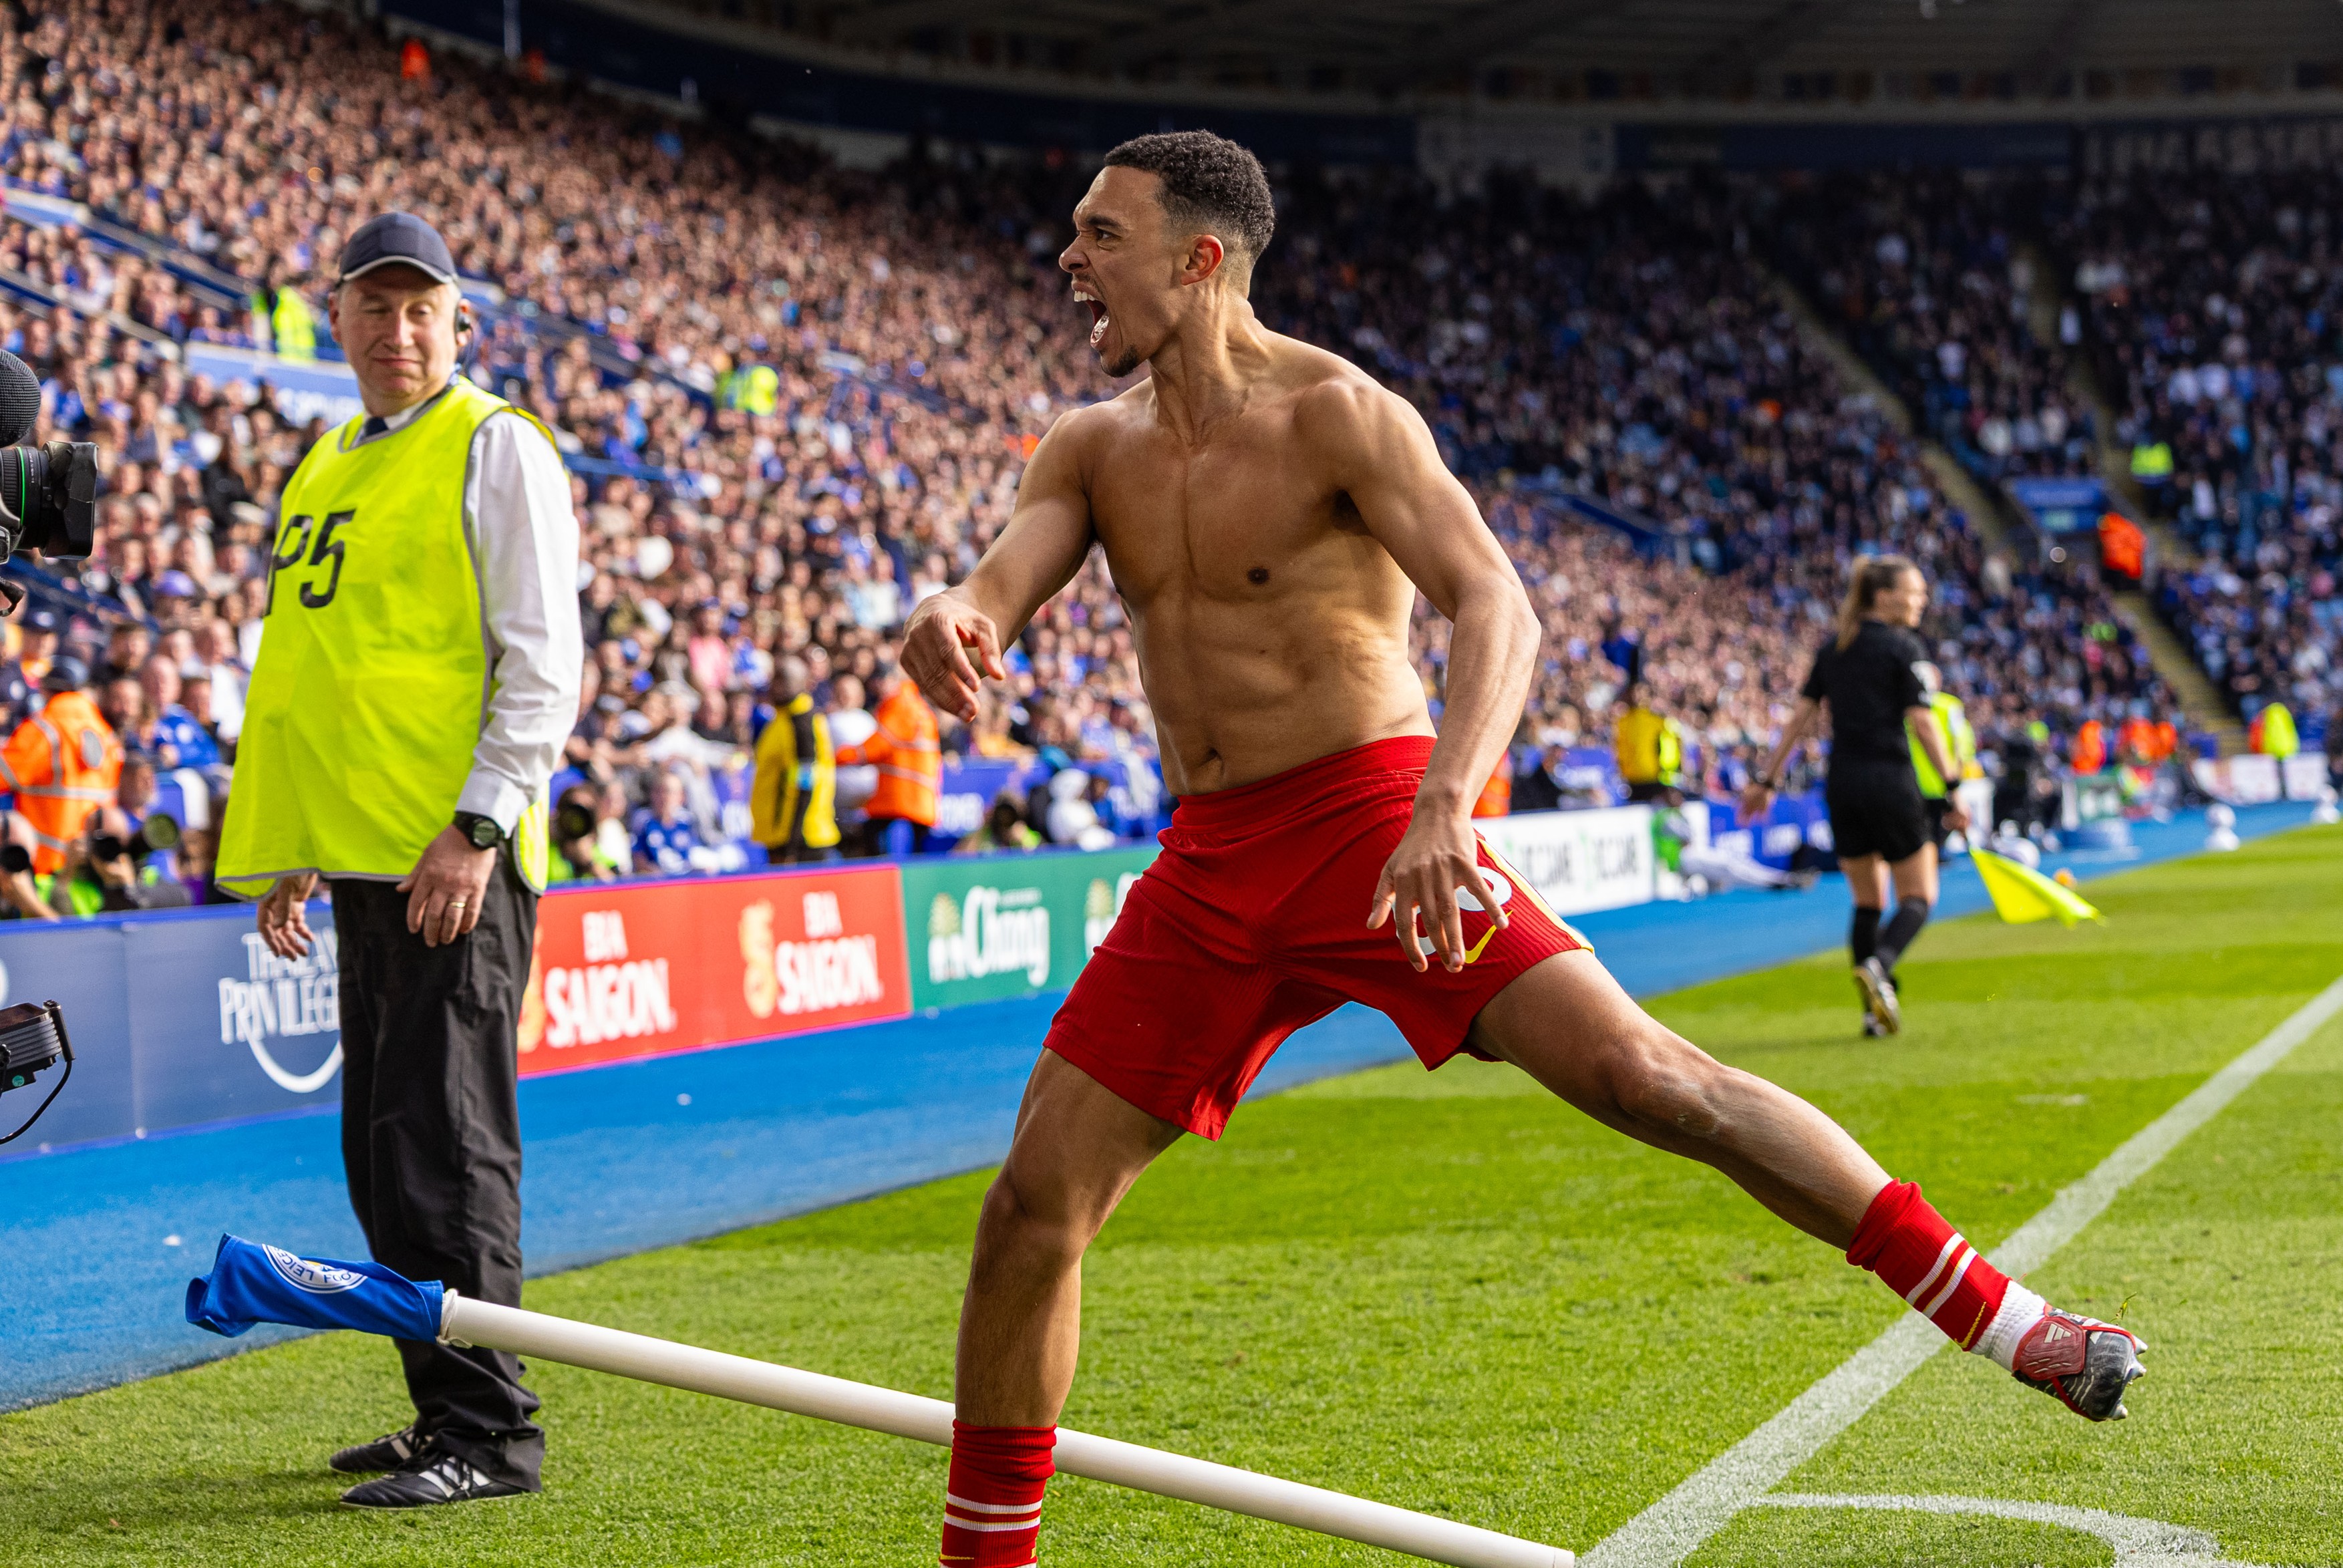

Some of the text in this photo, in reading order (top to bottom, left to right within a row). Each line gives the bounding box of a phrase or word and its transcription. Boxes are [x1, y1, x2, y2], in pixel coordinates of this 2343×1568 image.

[263, 508, 357, 617] P5
[218, 973, 340, 1044] PRIVILEG
[275, 1247, 315, 1281] LEICE
